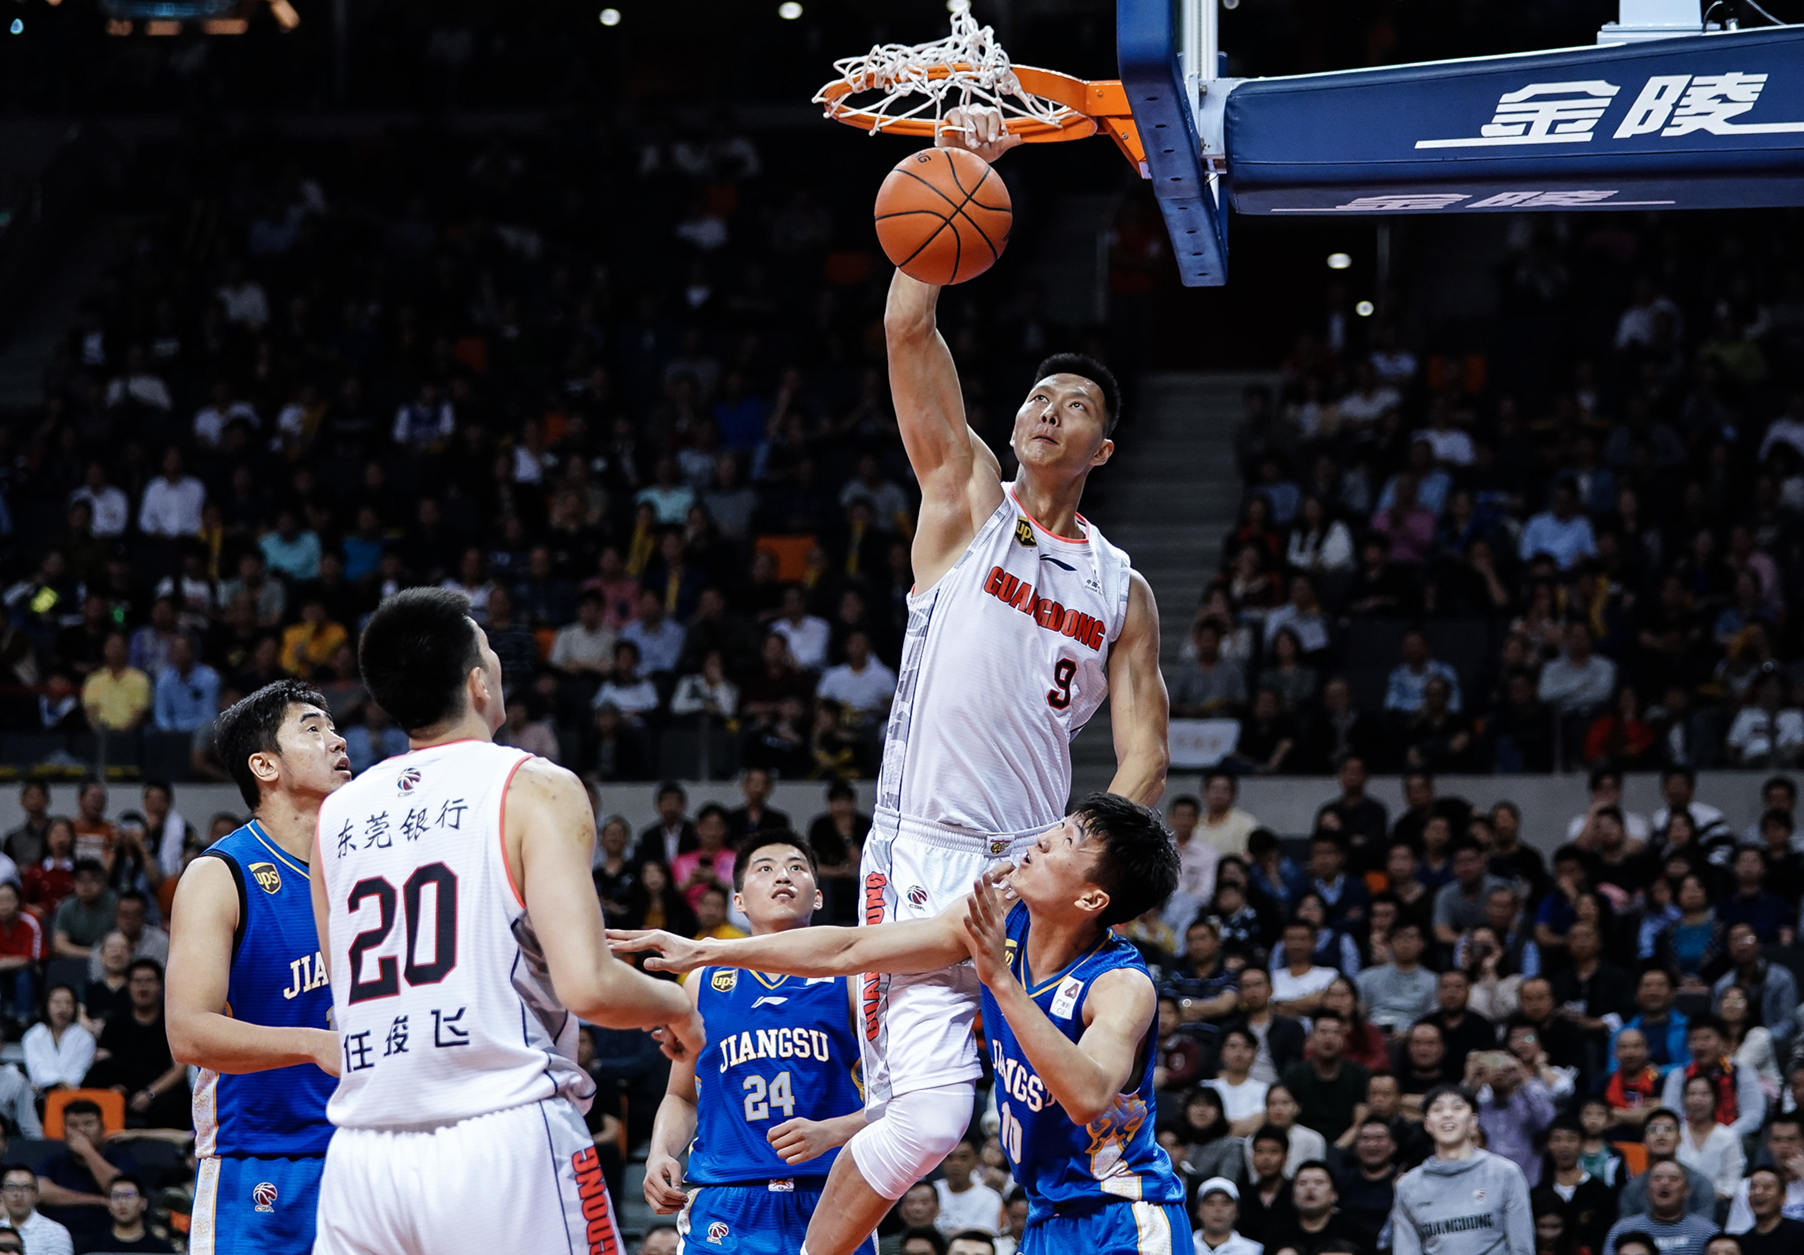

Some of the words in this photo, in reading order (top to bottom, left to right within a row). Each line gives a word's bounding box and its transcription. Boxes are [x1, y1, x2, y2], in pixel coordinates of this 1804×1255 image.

[1415, 72, 1804, 149] 金陵
[1272, 190, 1675, 213] 金陵
[983, 566, 1106, 652] GUANGDONG
[1047, 657, 1078, 710] 9
[336, 798, 469, 859] 东莞银行
[255, 870, 279, 890] ups
[347, 860, 459, 1007] 20
[719, 1027, 829, 1074] JIANGSU
[742, 1071, 796, 1122] 24
[1001, 1101, 1023, 1165] 10
